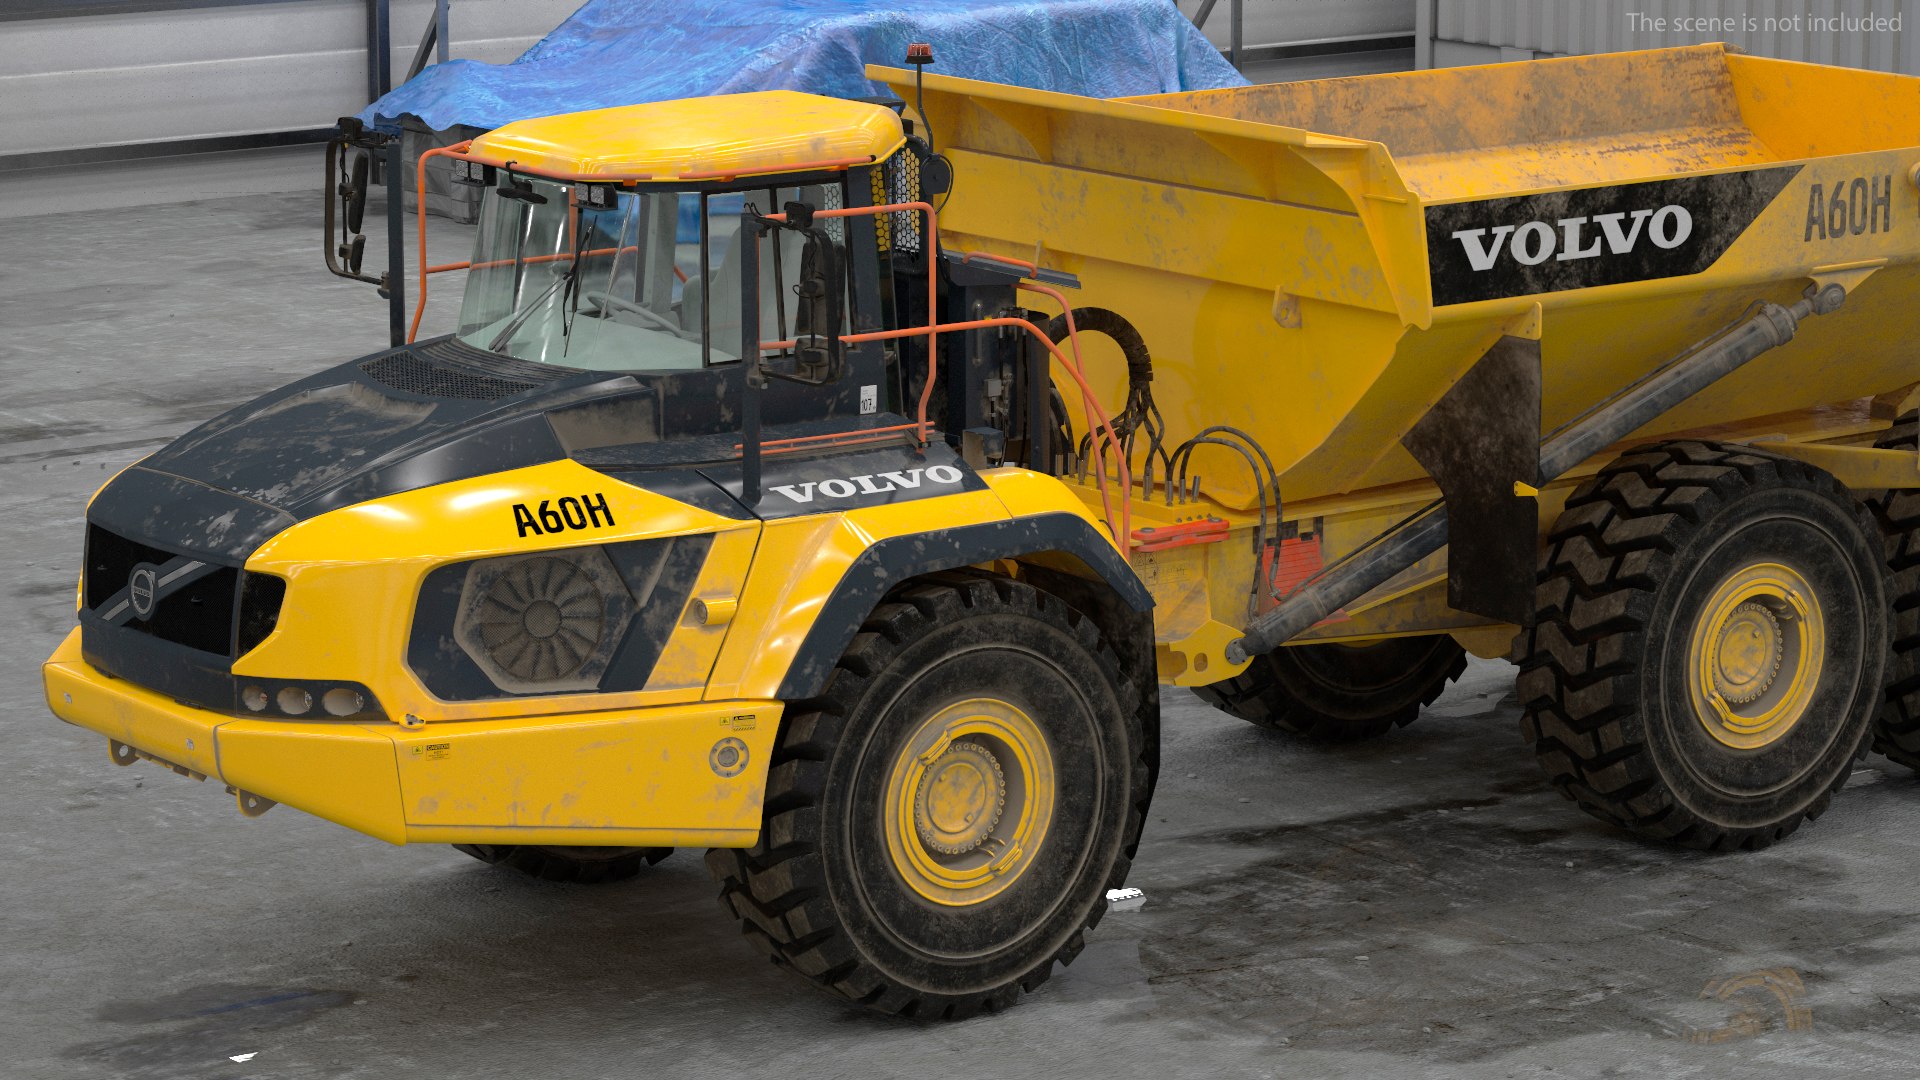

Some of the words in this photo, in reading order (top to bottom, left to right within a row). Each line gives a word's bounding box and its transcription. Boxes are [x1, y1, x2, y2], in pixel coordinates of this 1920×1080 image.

[1804, 174, 1891, 242] A60H
[1452, 204, 1693, 272] VOLVO
[768, 464, 964, 503] VOLVO
[512, 492, 615, 538] A60H
